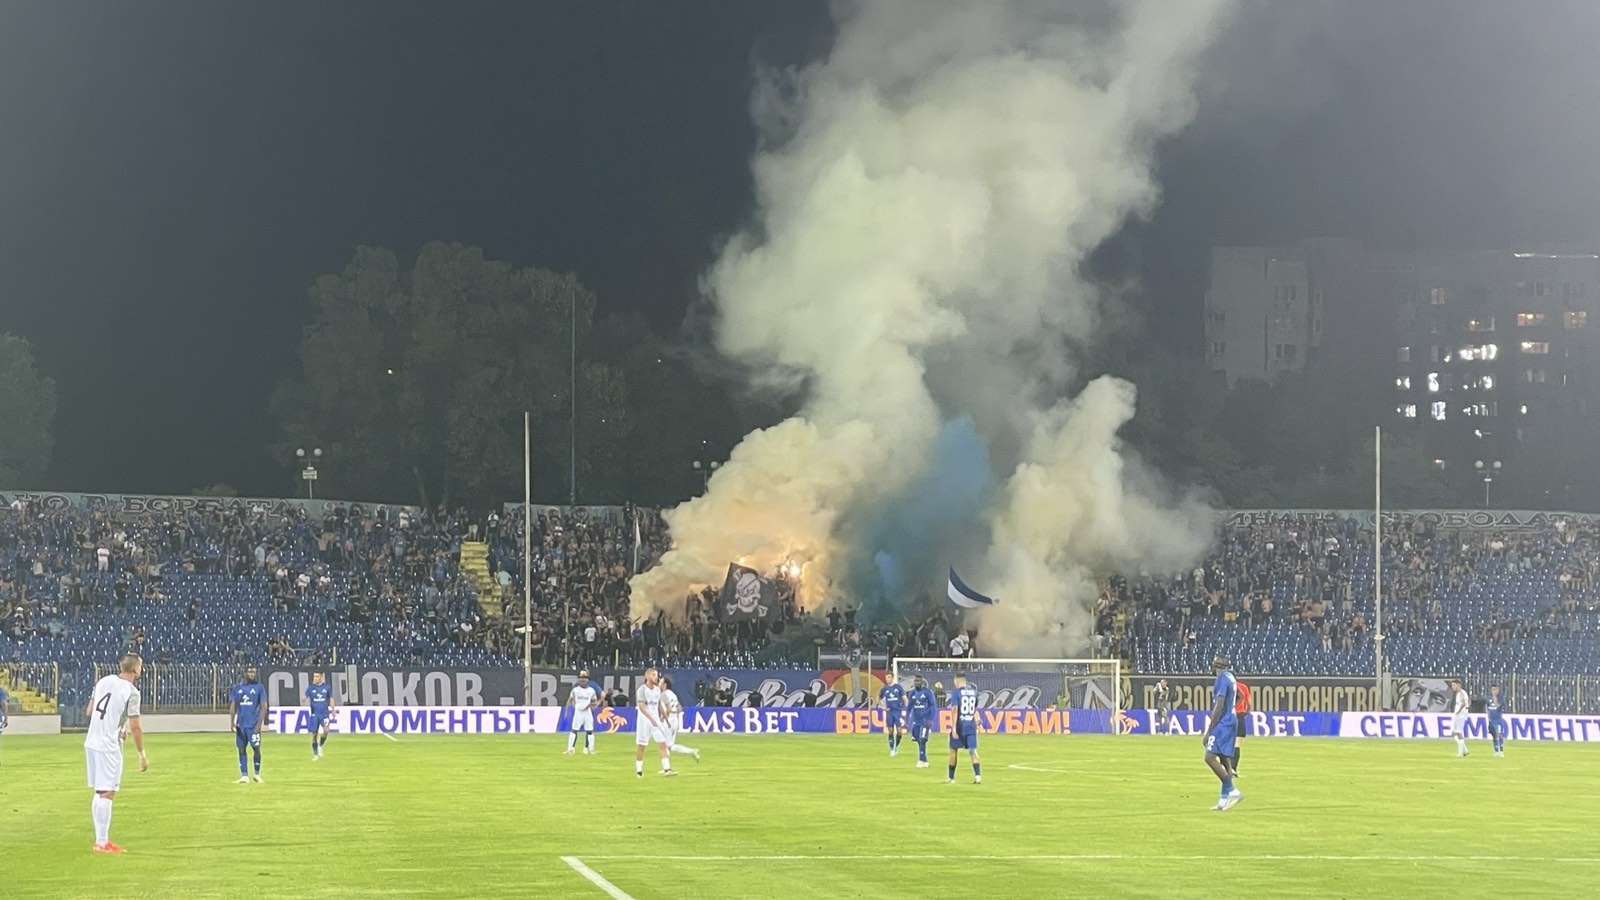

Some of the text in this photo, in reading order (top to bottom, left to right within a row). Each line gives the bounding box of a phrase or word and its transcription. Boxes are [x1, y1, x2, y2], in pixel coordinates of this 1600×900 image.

[95, 692, 112, 720] 4
[961, 696, 976, 714] 88
[350, 709, 535, 734] МОМЕНТЪТ!
[1360, 714, 1428, 738] СЕГА
